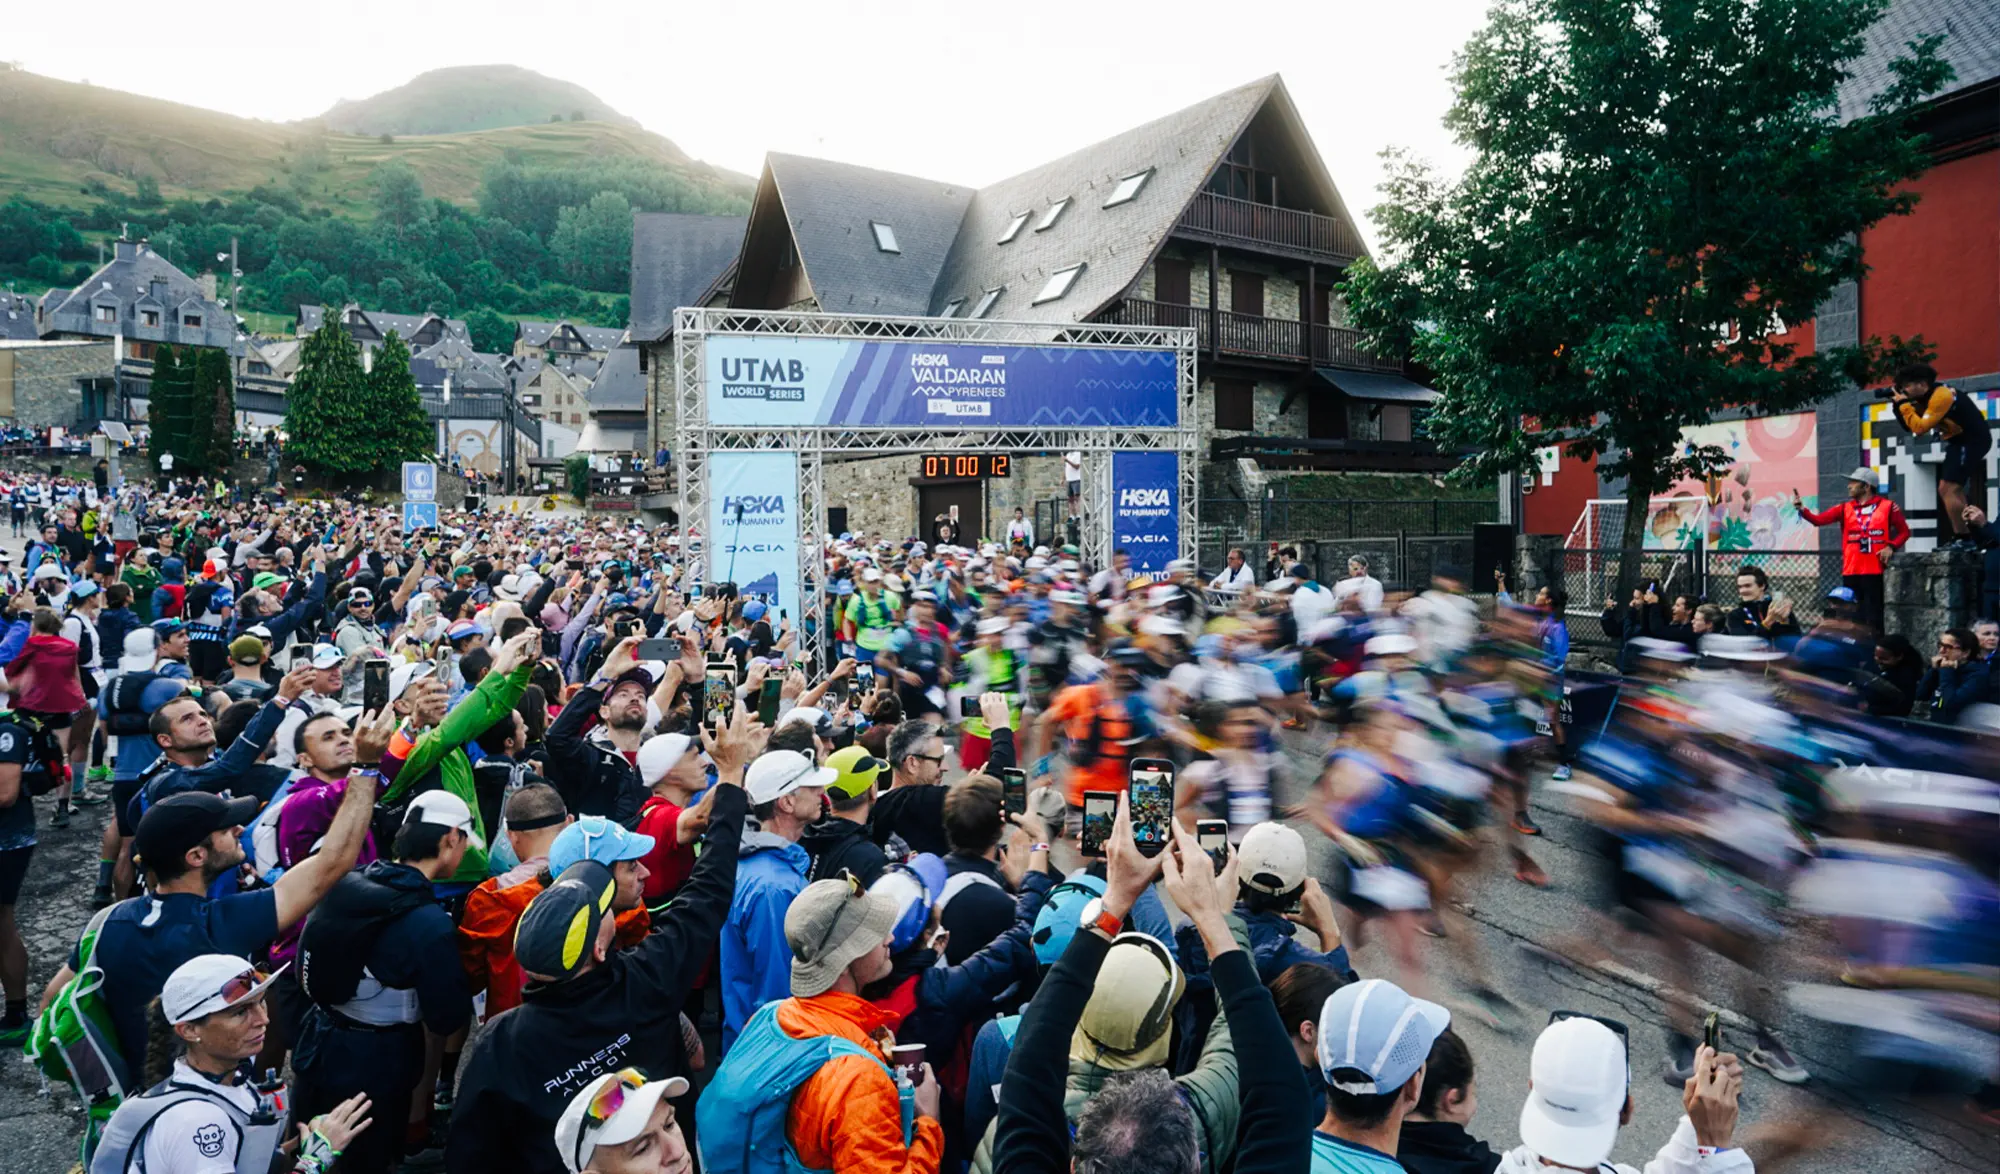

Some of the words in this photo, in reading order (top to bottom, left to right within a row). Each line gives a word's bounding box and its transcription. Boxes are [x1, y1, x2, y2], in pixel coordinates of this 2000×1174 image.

[911, 353, 949, 367] HOKA
[721, 357, 804, 383] UTMB
[725, 386, 766, 397] WORLD
[769, 389, 803, 400] SERIES
[948, 386, 1006, 397] PYRENEES
[932, 402, 944, 411] BY
[956, 404, 983, 413] UTMB
[926, 456, 949, 477] 07
[956, 456, 979, 476] 00
[991, 456, 1007, 475] 12
[722, 495, 785, 514] HOKA
[1120, 489, 1170, 506] HOKA
[722, 518, 737, 526] FLY
[739, 518, 770, 526] HUMAN
[771, 517, 785, 525] FLY
[1121, 535, 1169, 543] DACIA
[724, 544, 785, 553] DACIA
[543, 1033, 631, 1093] RUNNERS
[563, 1050, 627, 1097] ALCOI
